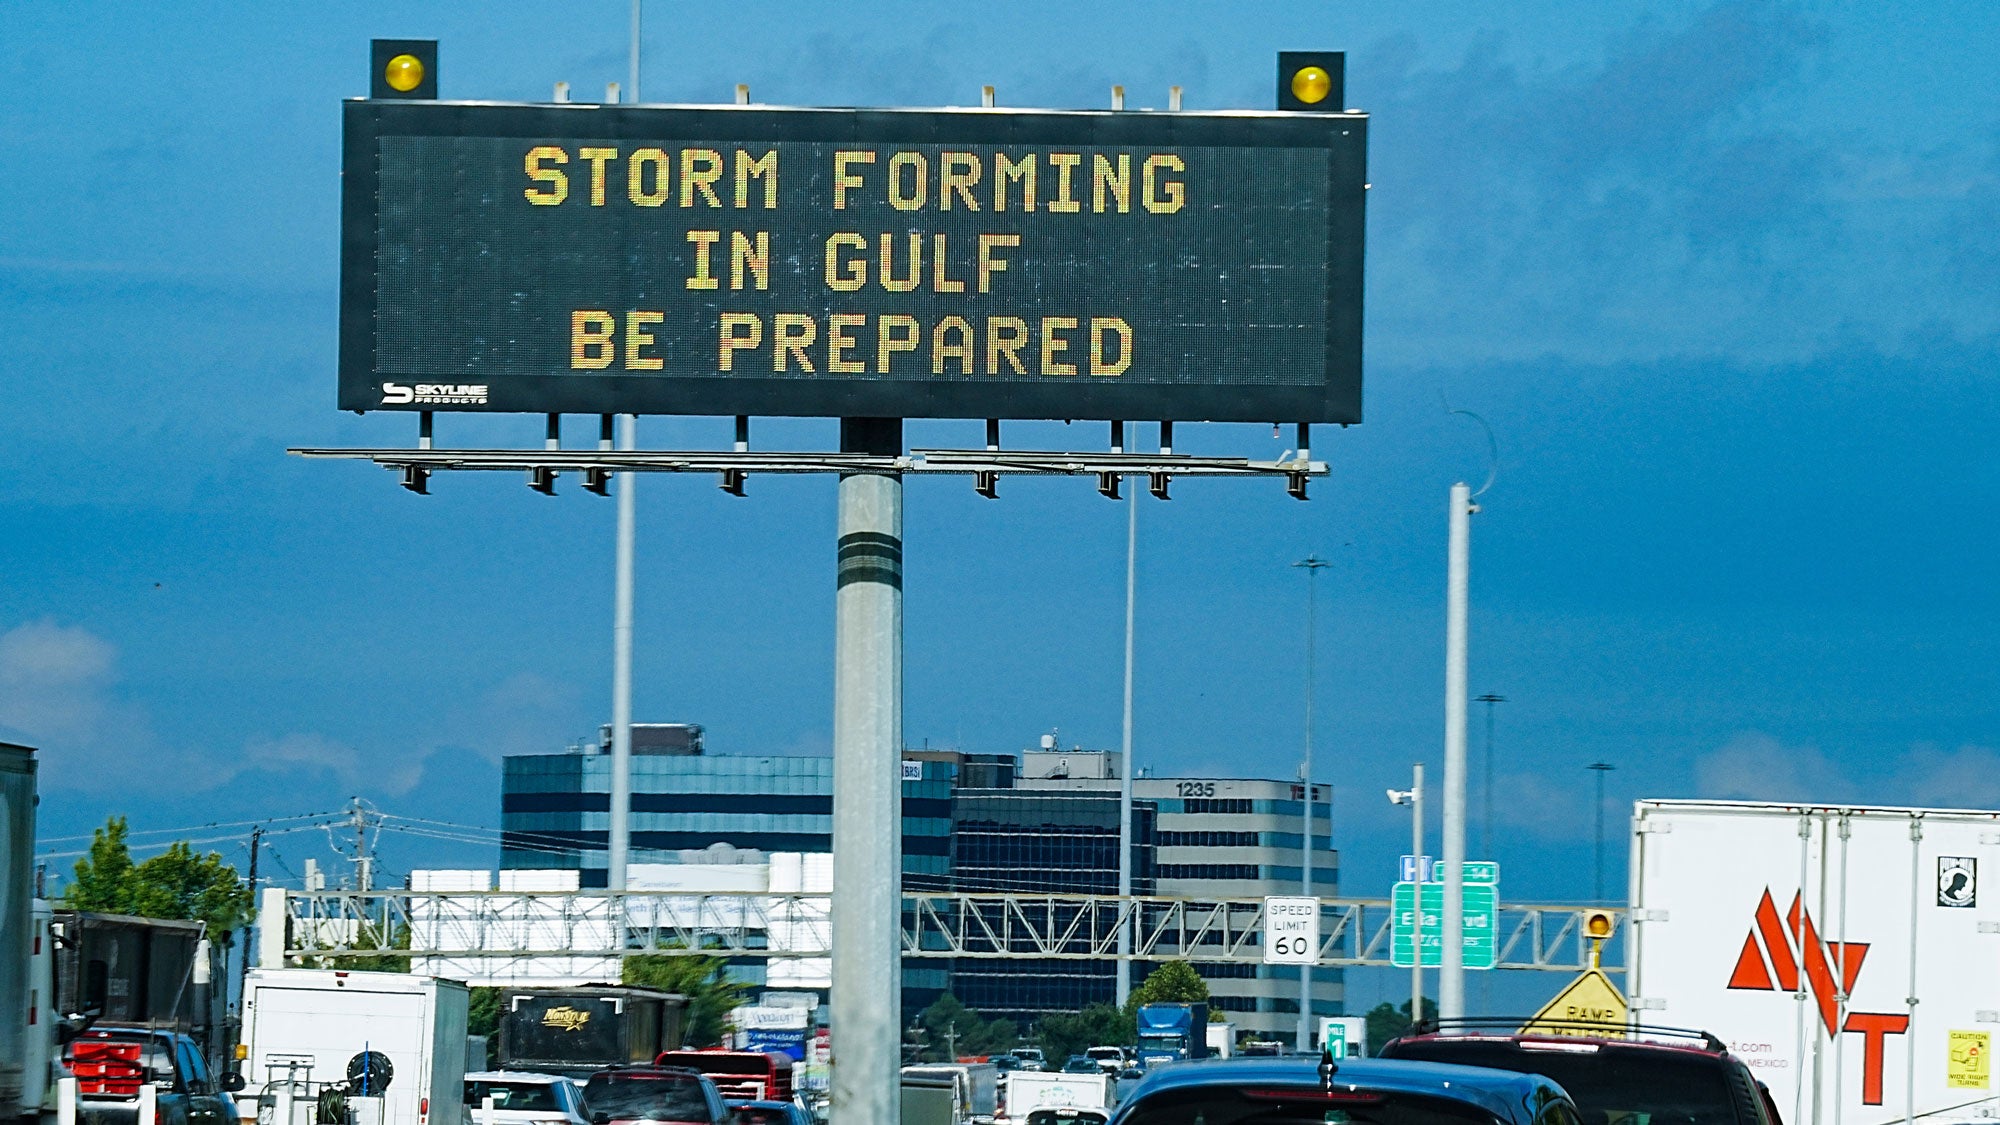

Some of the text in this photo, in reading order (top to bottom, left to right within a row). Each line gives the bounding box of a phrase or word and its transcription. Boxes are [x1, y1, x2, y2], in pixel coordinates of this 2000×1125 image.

[525, 146, 1186, 213] STORM FORMING
[686, 231, 1020, 292] IN GULF
[570, 310, 1134, 375] BE PREPARED
[414, 384, 488, 395] SKYLINE
[1175, 782, 1215, 798] 1235
[1270, 905, 1312, 916] SPEED
[1274, 921, 1307, 931] LIMIT
[1275, 936, 1308, 955] 60
[1567, 1006, 1616, 1022] RAMP
[1328, 1027, 1344, 1035] MILE
[1332, 1039, 1342, 1059] 1
[1748, 1059, 1789, 1068] MEXICO
